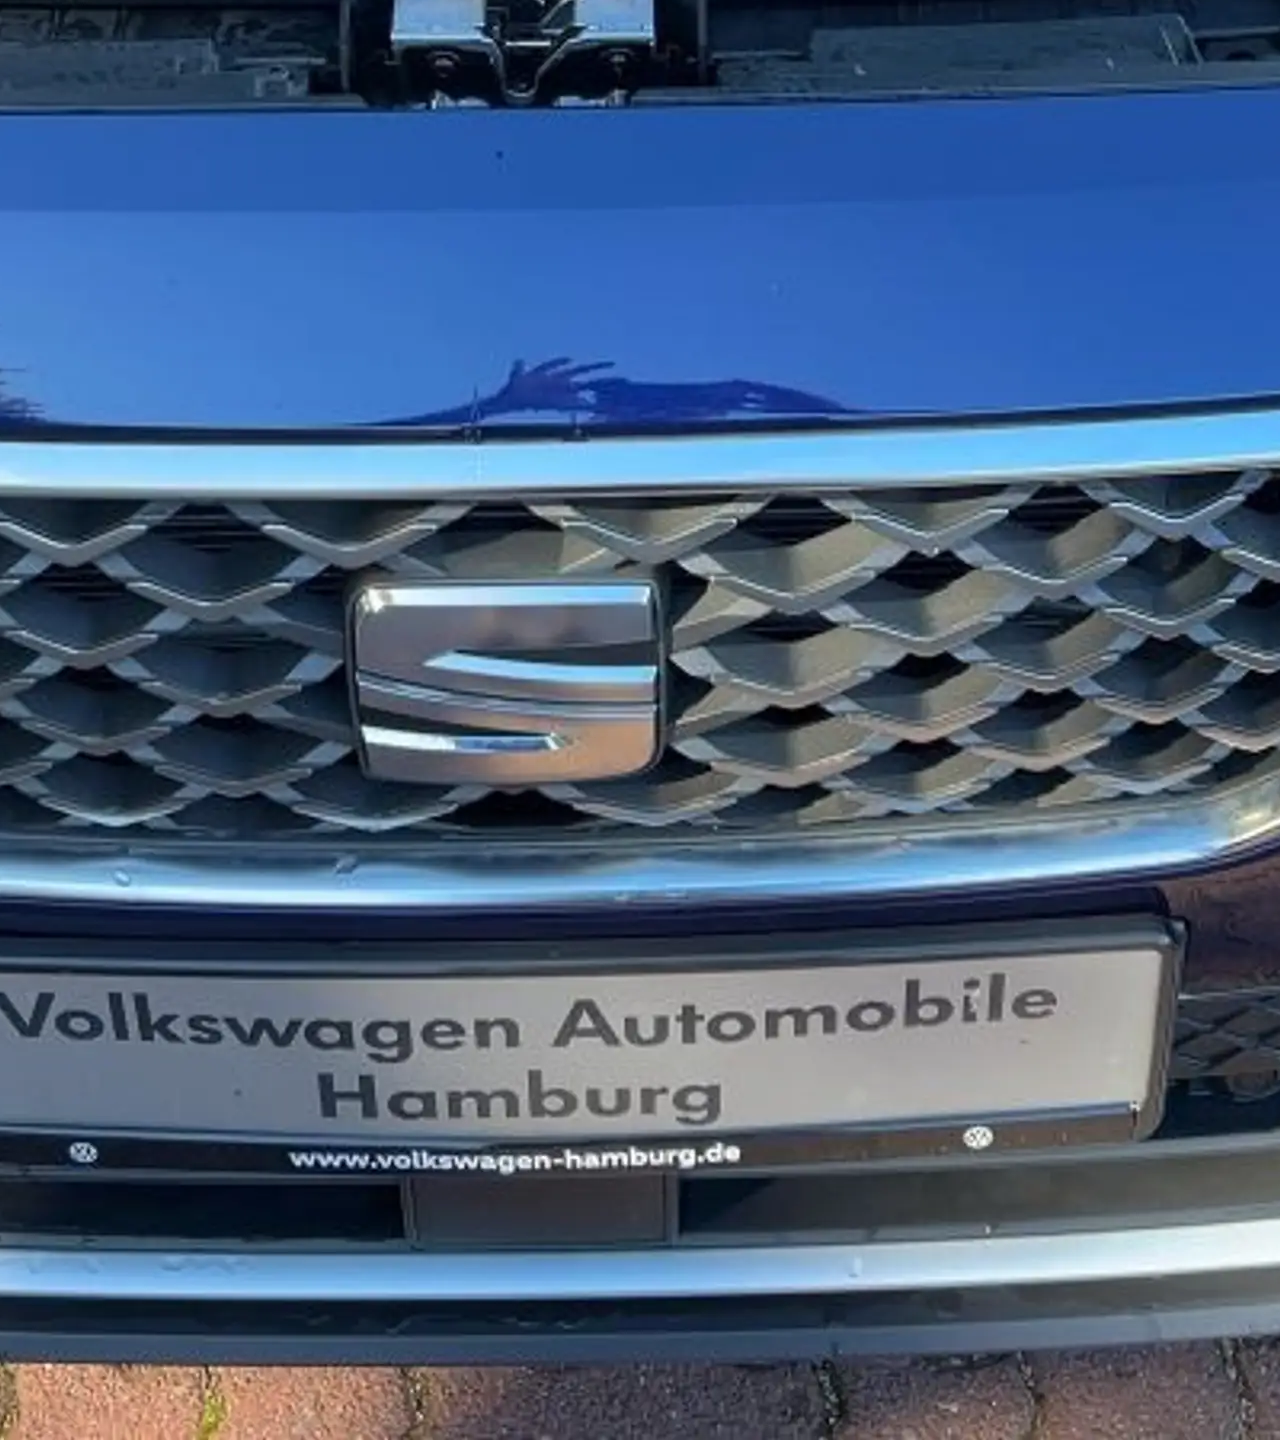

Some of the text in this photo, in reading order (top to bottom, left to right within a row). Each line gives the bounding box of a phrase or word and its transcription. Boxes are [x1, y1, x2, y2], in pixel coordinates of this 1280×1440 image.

[552, 972, 1058, 1047] Automobile
[317, 1070, 722, 1125] Hamburg
[288, 1143, 741, 1175] www.volkswagen-hamburg.de
